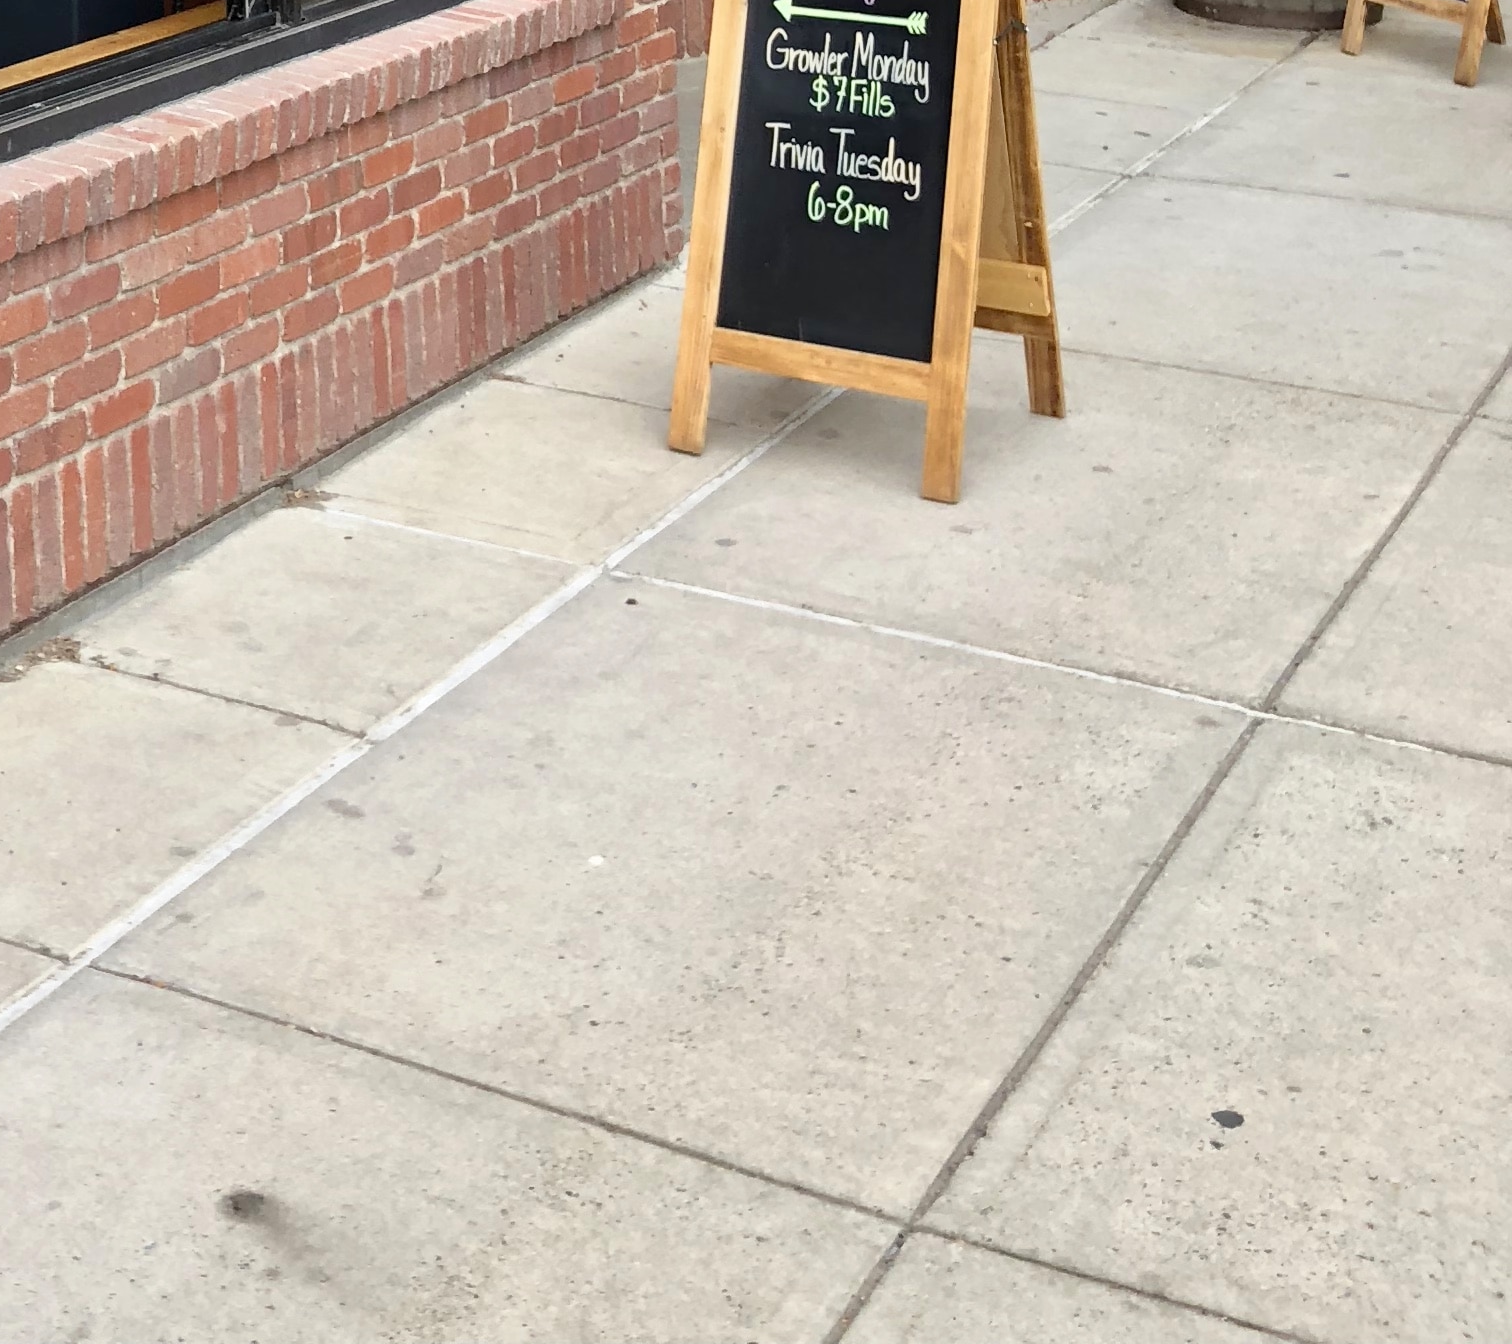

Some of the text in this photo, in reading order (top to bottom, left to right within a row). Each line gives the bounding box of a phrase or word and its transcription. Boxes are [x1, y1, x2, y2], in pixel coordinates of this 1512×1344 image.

[766, 28, 930, 104] Growler Monday
[850, 81, 895, 118] Fills
[765, 121, 922, 202] Trivia Tuesday
[807, 181, 889, 234] 6-8pm
